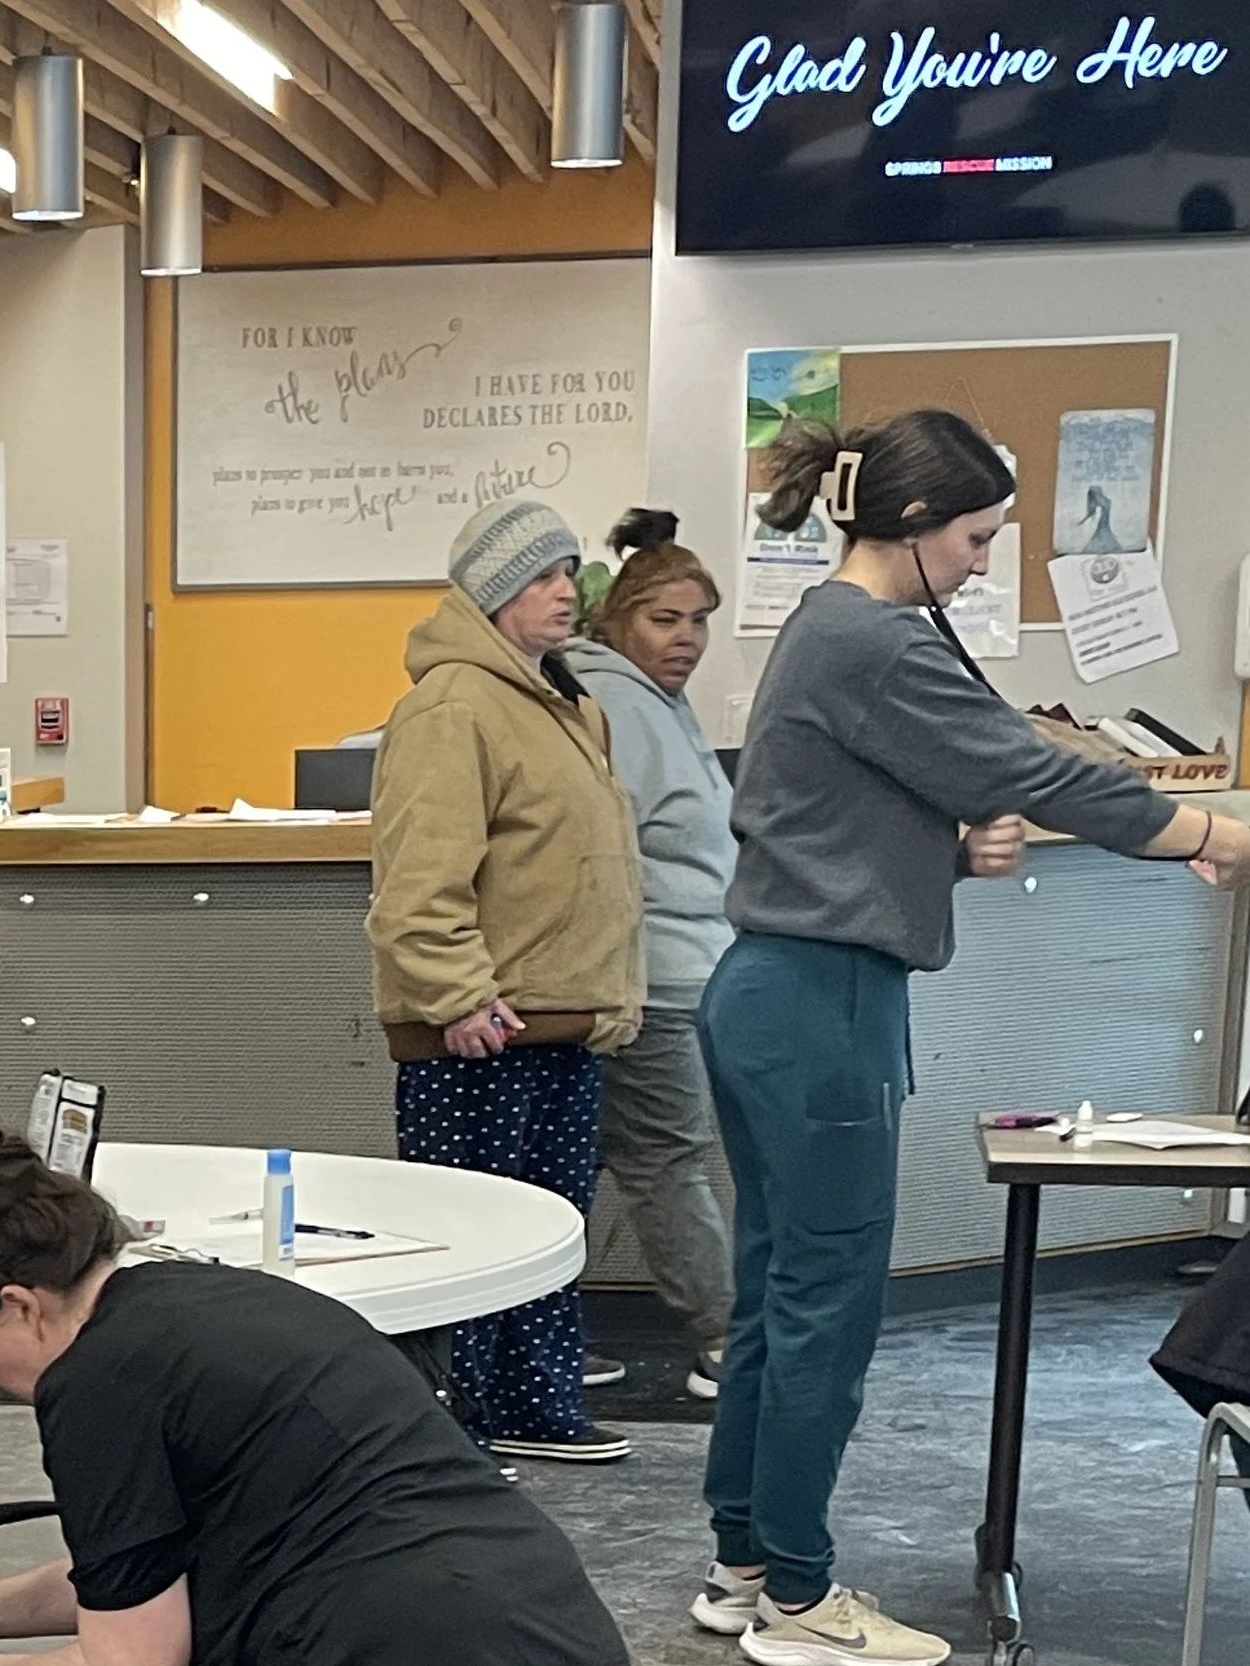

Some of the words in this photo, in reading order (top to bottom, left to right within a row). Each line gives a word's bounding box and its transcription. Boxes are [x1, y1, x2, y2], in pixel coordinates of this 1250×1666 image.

[725, 34, 868, 134] Glad
[871, 25, 1057, 127] You're
[1075, 15, 1229, 90] Here
[996, 155, 1053, 172] MISSION
[241, 327, 278, 349] FOR
[286, 326, 294, 348] I
[301, 326, 358, 347] KNOW
[475, 375, 481, 397] I
[489, 374, 542, 396] HAVE
[551, 372, 587, 394] FOR
[595, 370, 636, 393] YOU
[264, 370, 320, 424] the
[423, 405, 523, 429] DECLARES
[529, 403, 566, 425] THE
[343, 484, 418, 532] hope
[1170, 763, 1229, 781] LOVE
